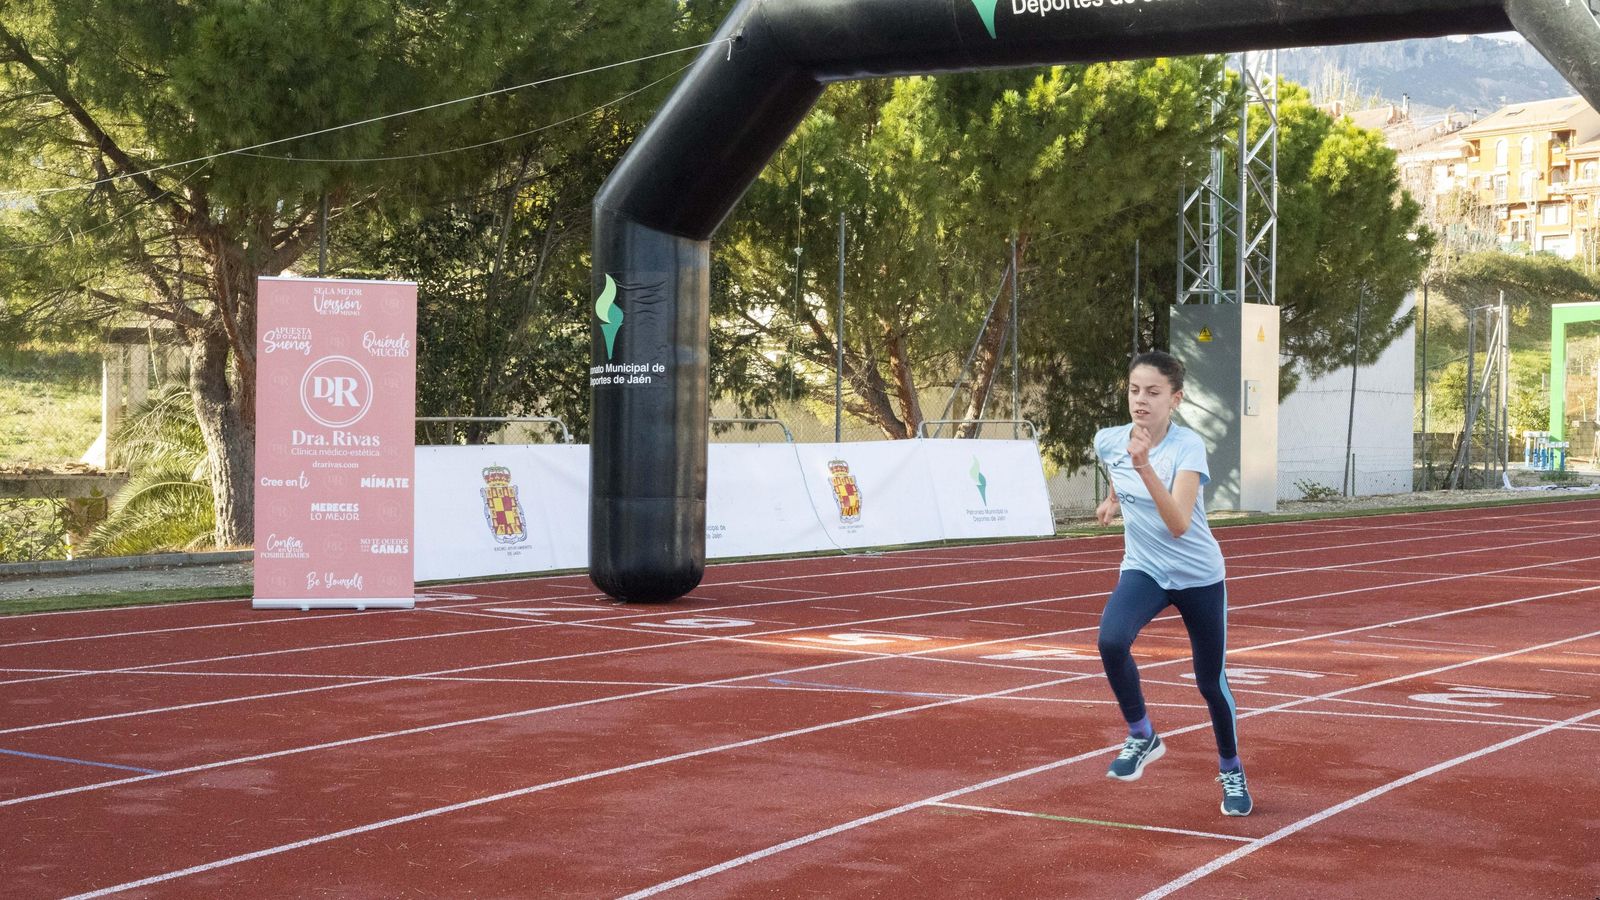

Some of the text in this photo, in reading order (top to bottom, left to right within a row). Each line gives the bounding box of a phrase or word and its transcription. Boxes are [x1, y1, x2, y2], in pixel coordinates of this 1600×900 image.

[274, 327, 312, 335] APUESTA
[371, 349, 409, 358] MUCHO
[605, 363, 650, 374] Municipal
[651, 363, 666, 372] de
[613, 374, 625, 384] de
[627, 374, 652, 384] Jaén
[291, 430, 381, 447] Dra. Rivas
[260, 477, 283, 487] Cree
[285, 479, 298, 487] en
[360, 474, 409, 488] MÍMATE
[311, 503, 359, 512] MERECES
[310, 513, 360, 521] LO MEJOR
[371, 544, 409, 554] GANAS
